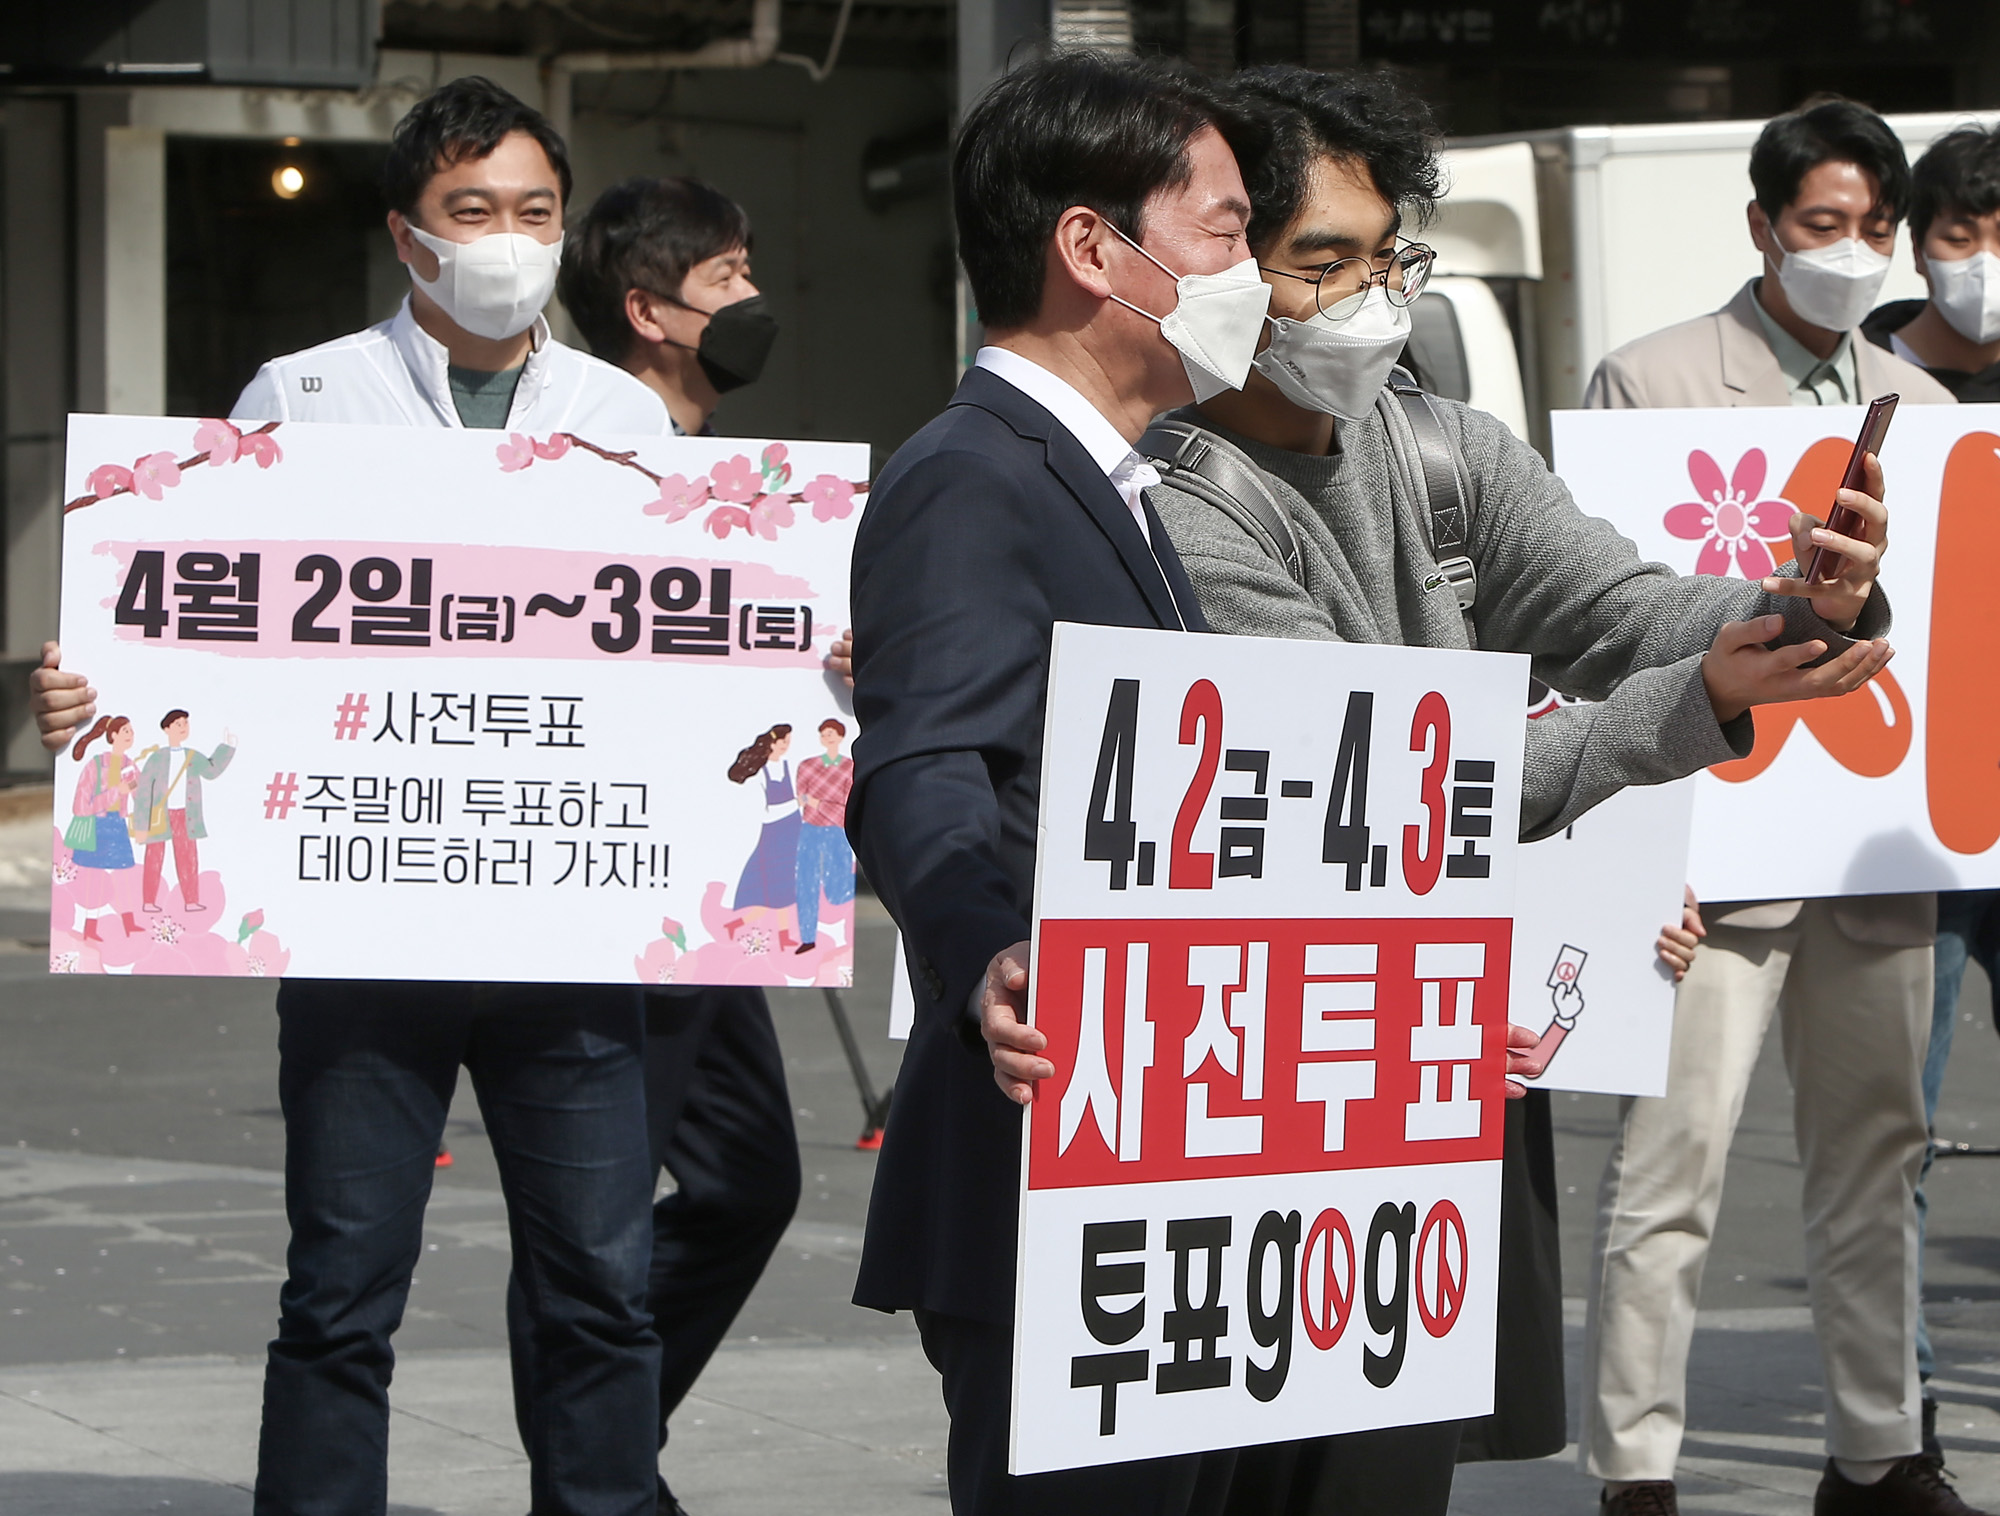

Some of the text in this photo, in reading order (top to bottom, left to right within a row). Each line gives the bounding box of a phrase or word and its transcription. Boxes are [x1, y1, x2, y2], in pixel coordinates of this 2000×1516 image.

[115, 550, 260, 642] 4월
[333, 692, 584, 747] #사전투표
[264, 774, 648, 828] #주말에 투표하고
[299, 836, 669, 888] 데이트하러 가자!!
[1058, 941, 1488, 1162] 사전투표
